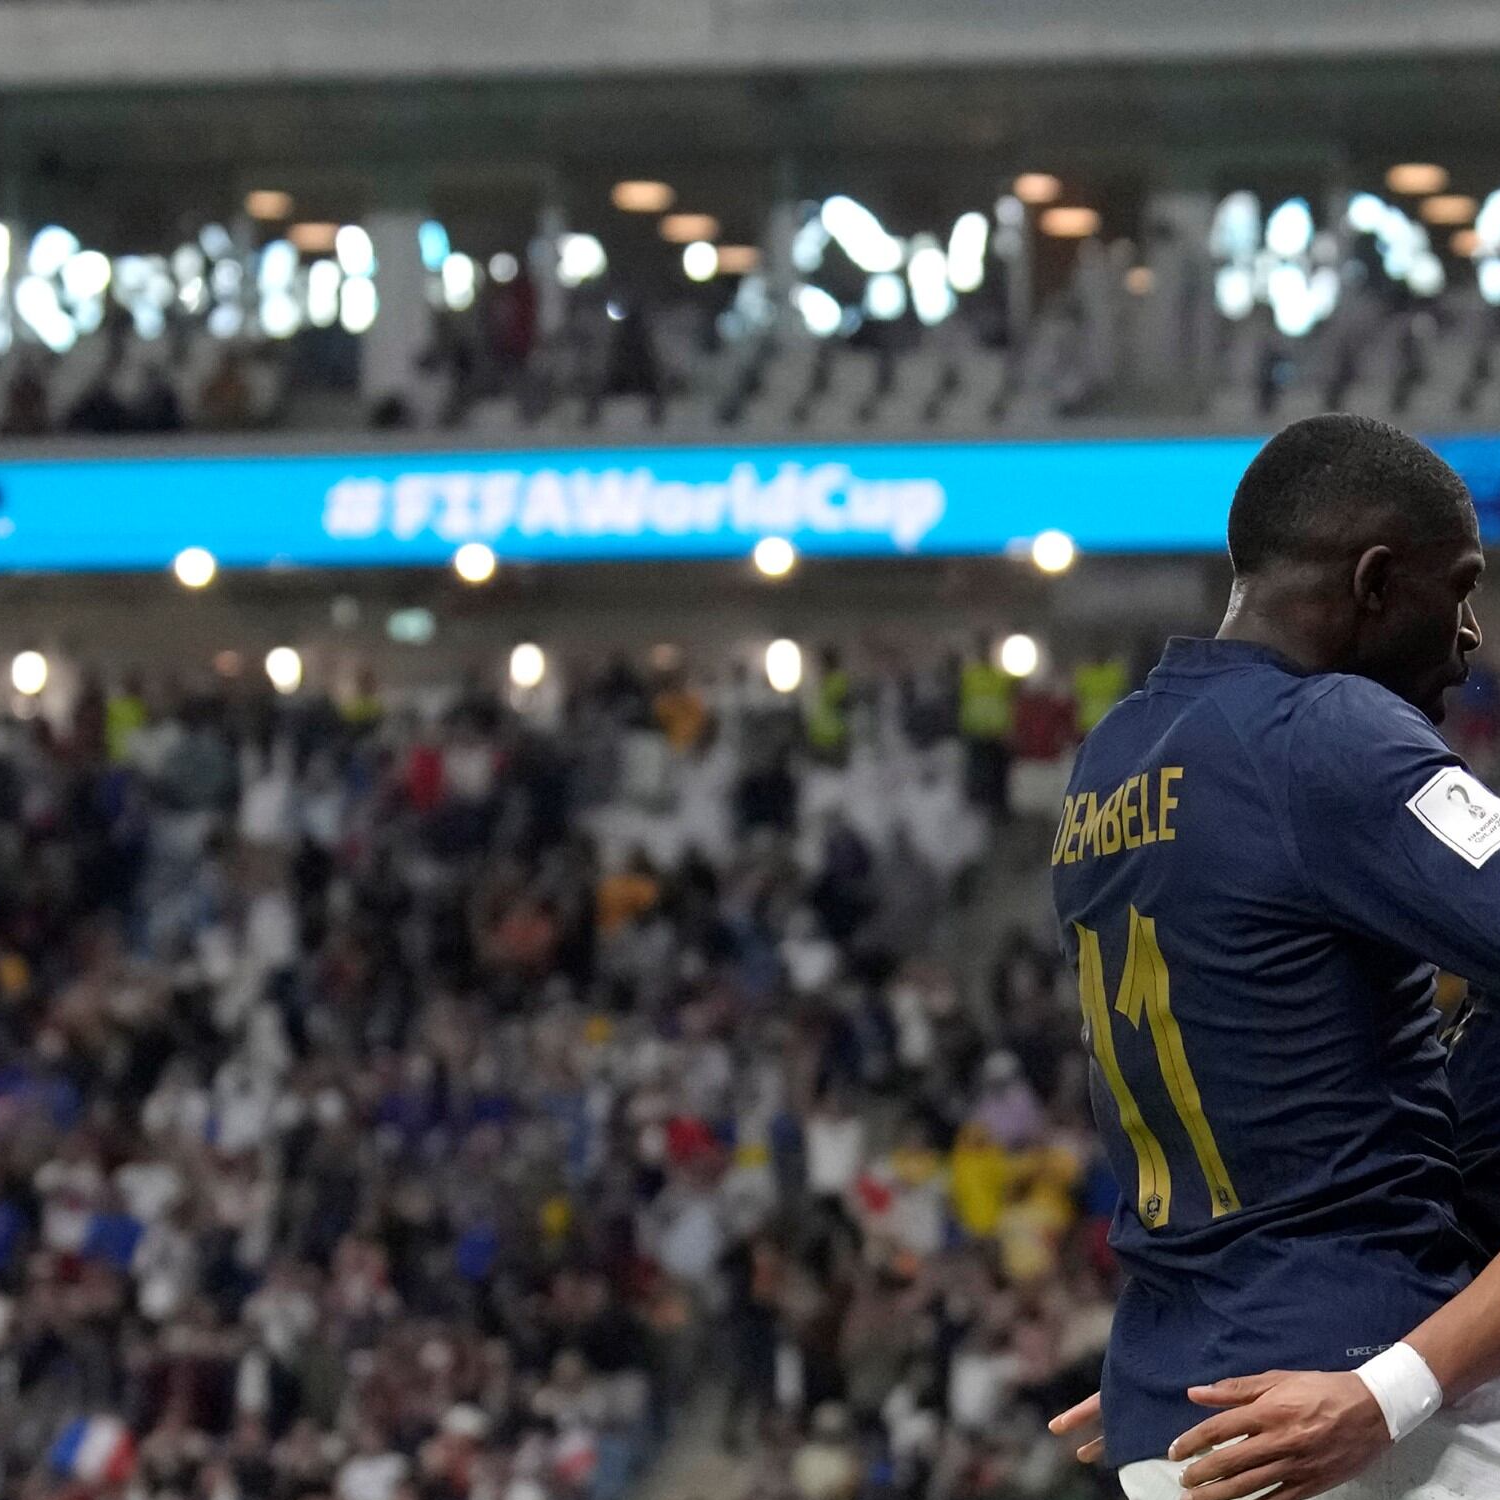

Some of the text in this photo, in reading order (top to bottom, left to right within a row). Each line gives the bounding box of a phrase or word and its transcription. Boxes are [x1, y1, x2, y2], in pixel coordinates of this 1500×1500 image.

[324, 462, 946, 549] #FIFAWorldCup
[1051, 766, 1183, 866] DEMBELE
[1072, 903, 1242, 1228] 11
[1346, 1344, 1394, 1357] DRI-F
